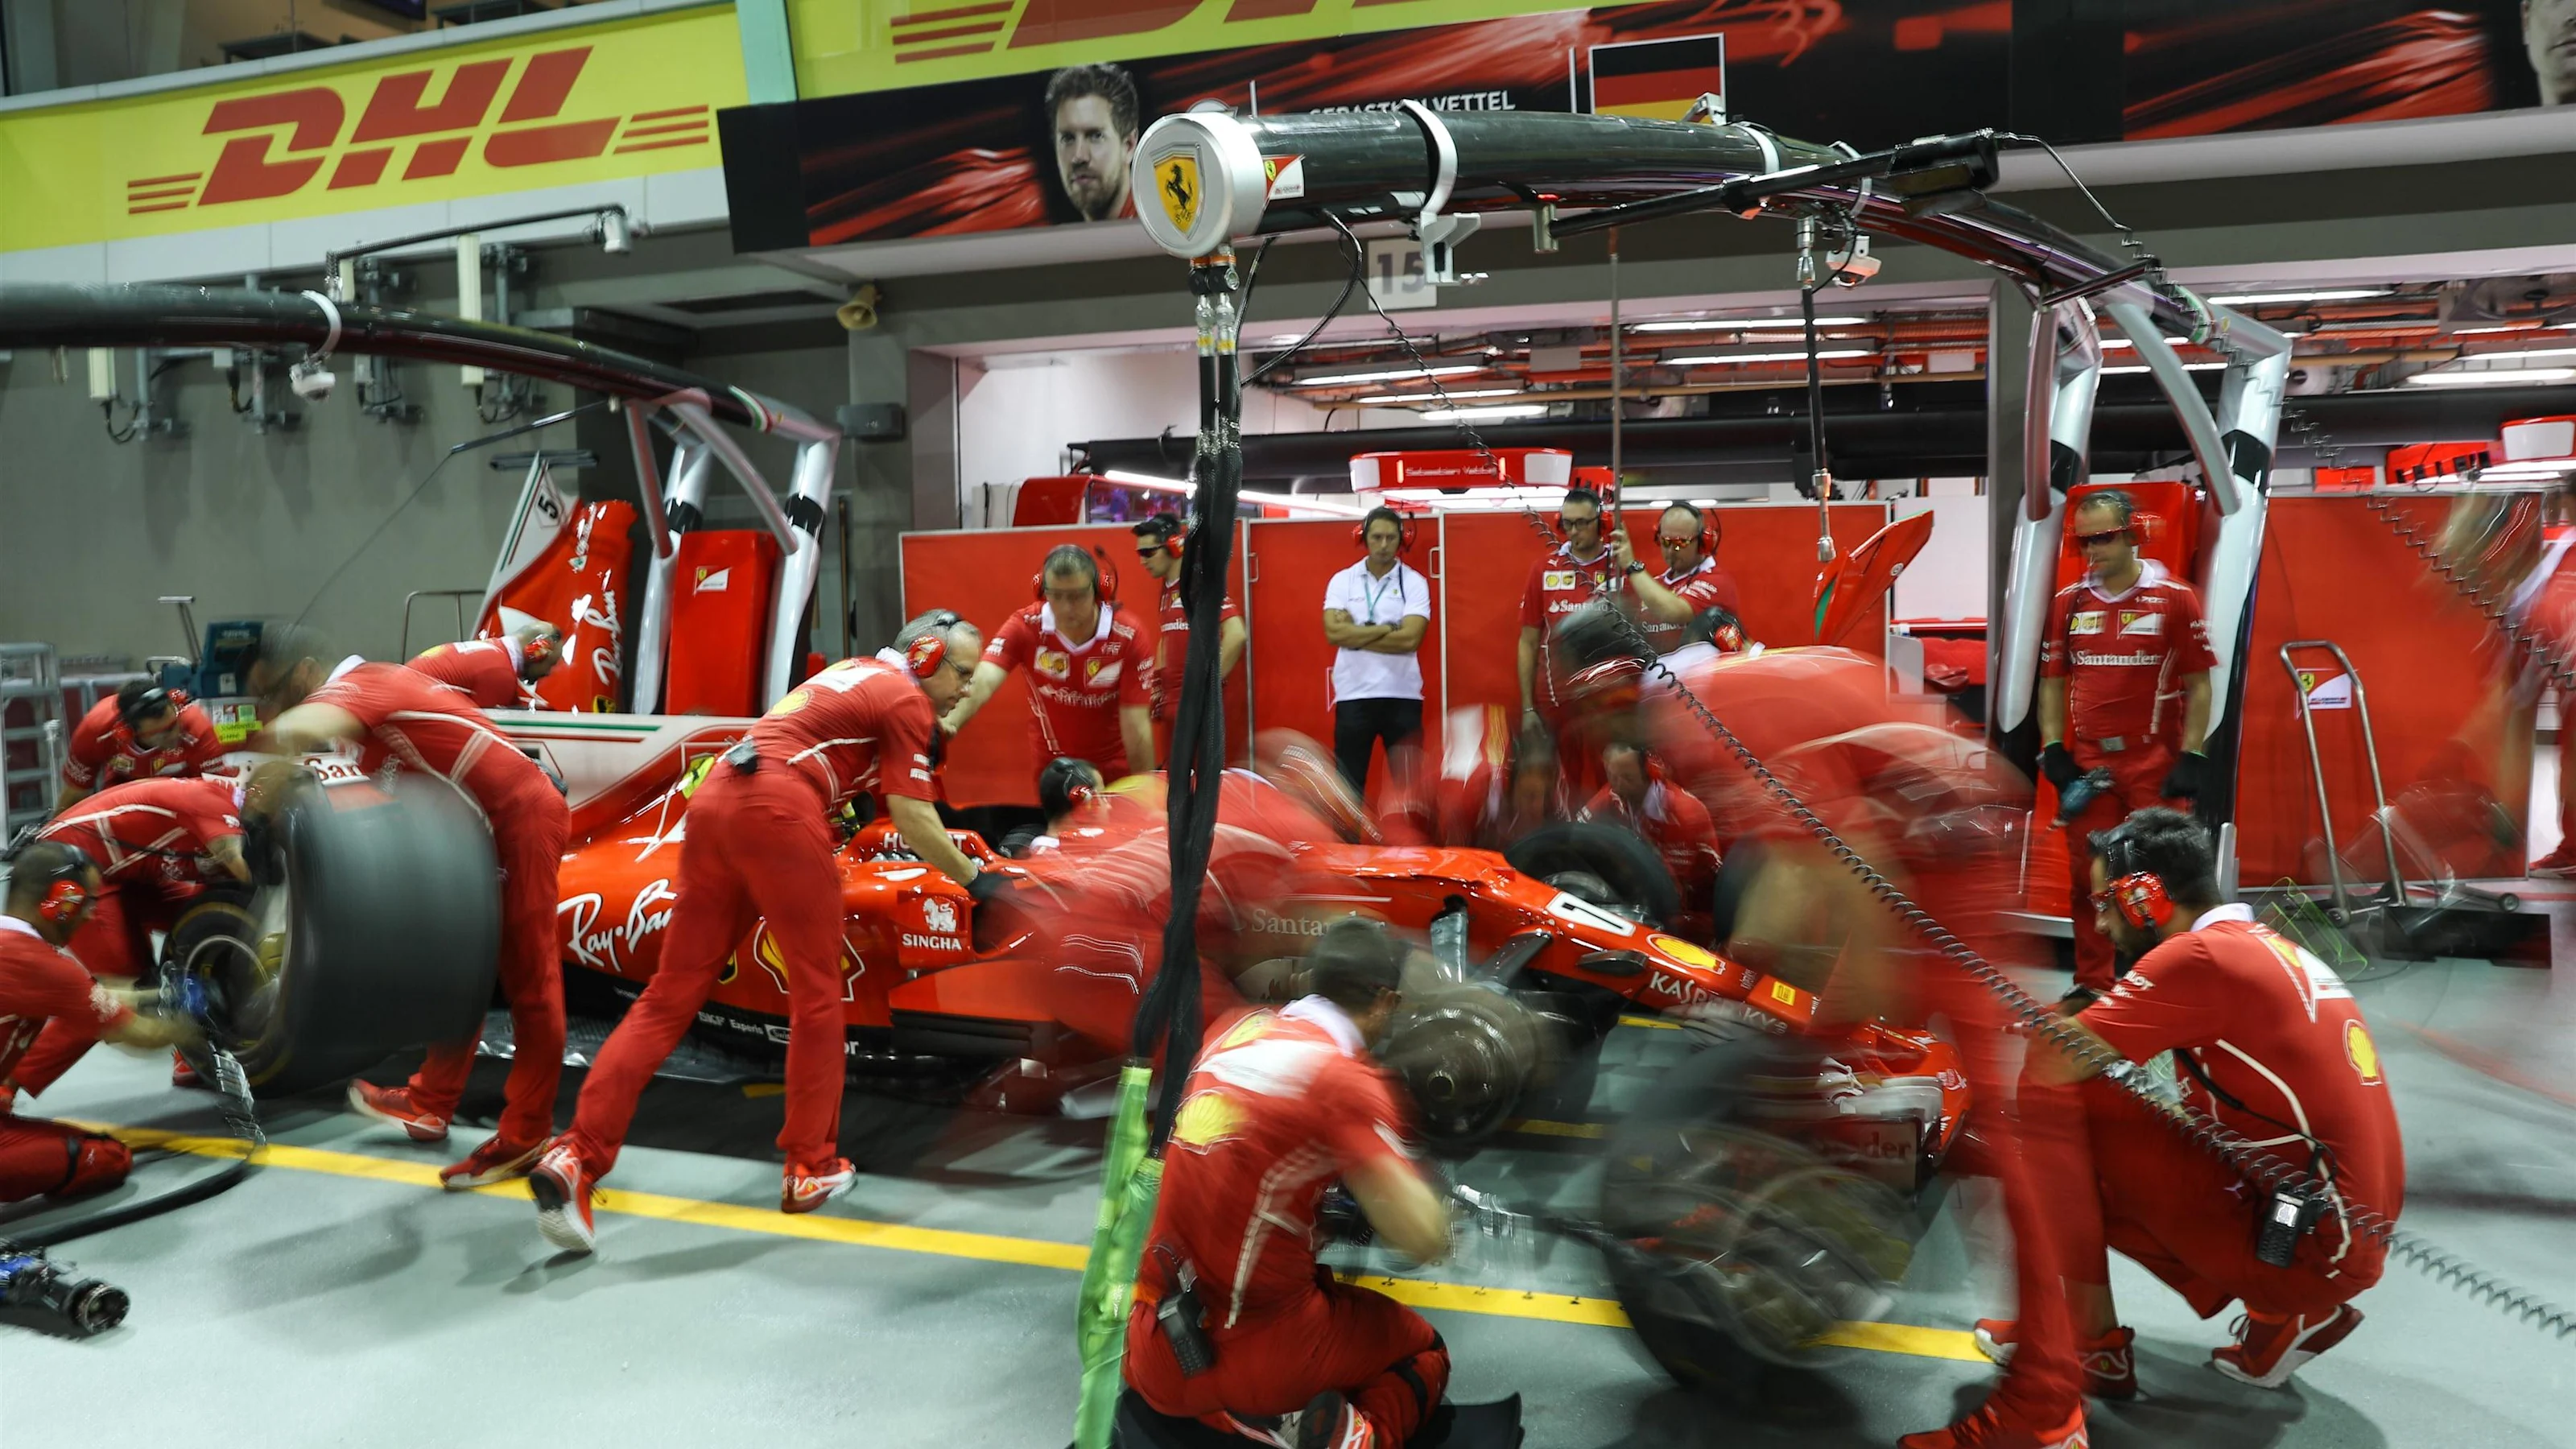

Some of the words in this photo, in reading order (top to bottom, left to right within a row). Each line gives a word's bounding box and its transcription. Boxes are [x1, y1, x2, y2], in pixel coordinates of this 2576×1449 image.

[1432, 90, 1516, 112] VETTEL
[197, 45, 621, 206] DHL
[1377, 251, 1425, 295] 15
[1462, 465, 1496, 476] Vette
[537, 493, 559, 520] 5
[2077, 649, 2161, 667] Santander
[902, 933, 963, 952] SINGHA
